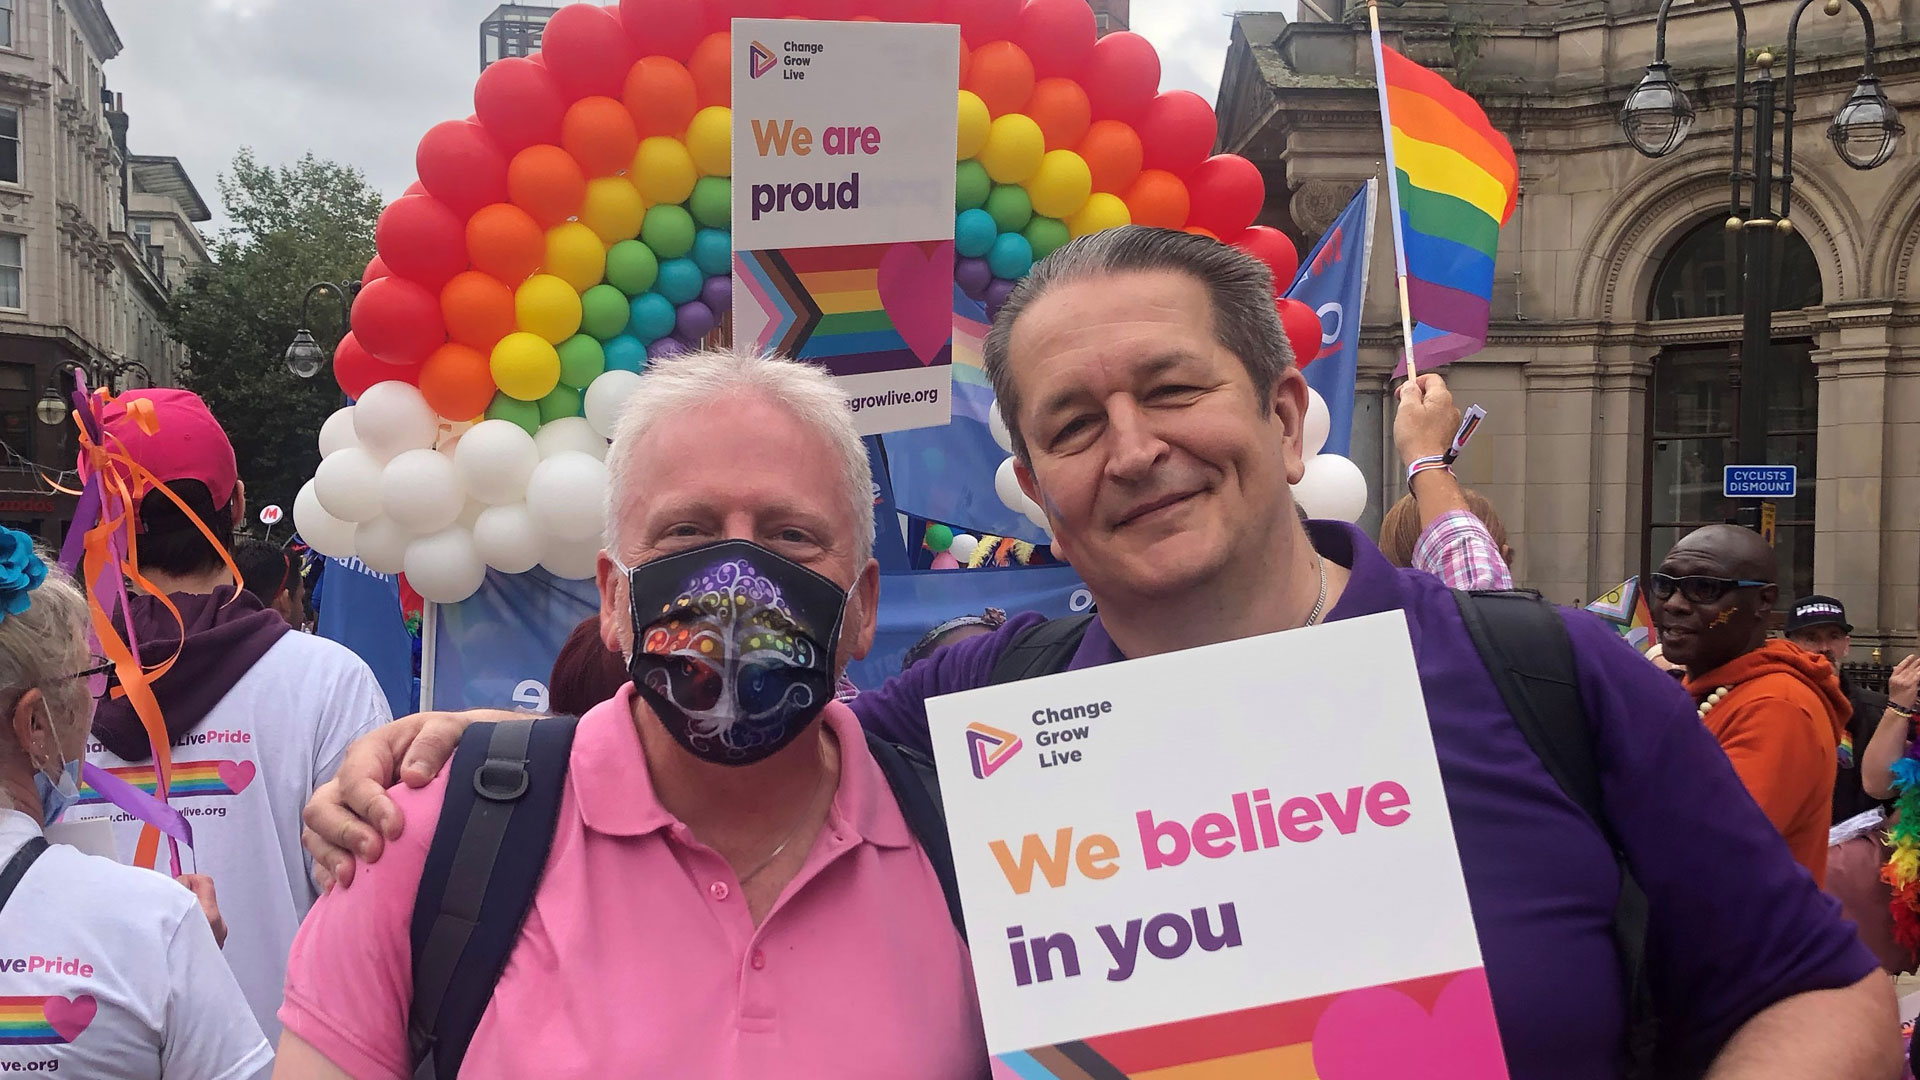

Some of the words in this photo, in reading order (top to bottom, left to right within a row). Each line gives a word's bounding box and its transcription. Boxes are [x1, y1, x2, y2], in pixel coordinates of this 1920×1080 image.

[784, 41, 823, 54] Change
[784, 55, 811, 66] Grow
[783, 69, 805, 80] Live
[751, 120, 812, 156] We
[823, 126, 881, 155] are
[752, 172, 859, 220] proud
[1734, 471, 1787, 480] CYCLISTS
[1730, 482, 1791, 491] DISMOUNT
[1032, 701, 1112, 726] Change
[1036, 726, 1089, 746] Grow
[1039, 750, 1082, 768] Live
[989, 827, 1120, 895] We
[1136, 780, 1411, 870] believe
[1006, 925, 1081, 987] in
[1095, 902, 1243, 982] you
